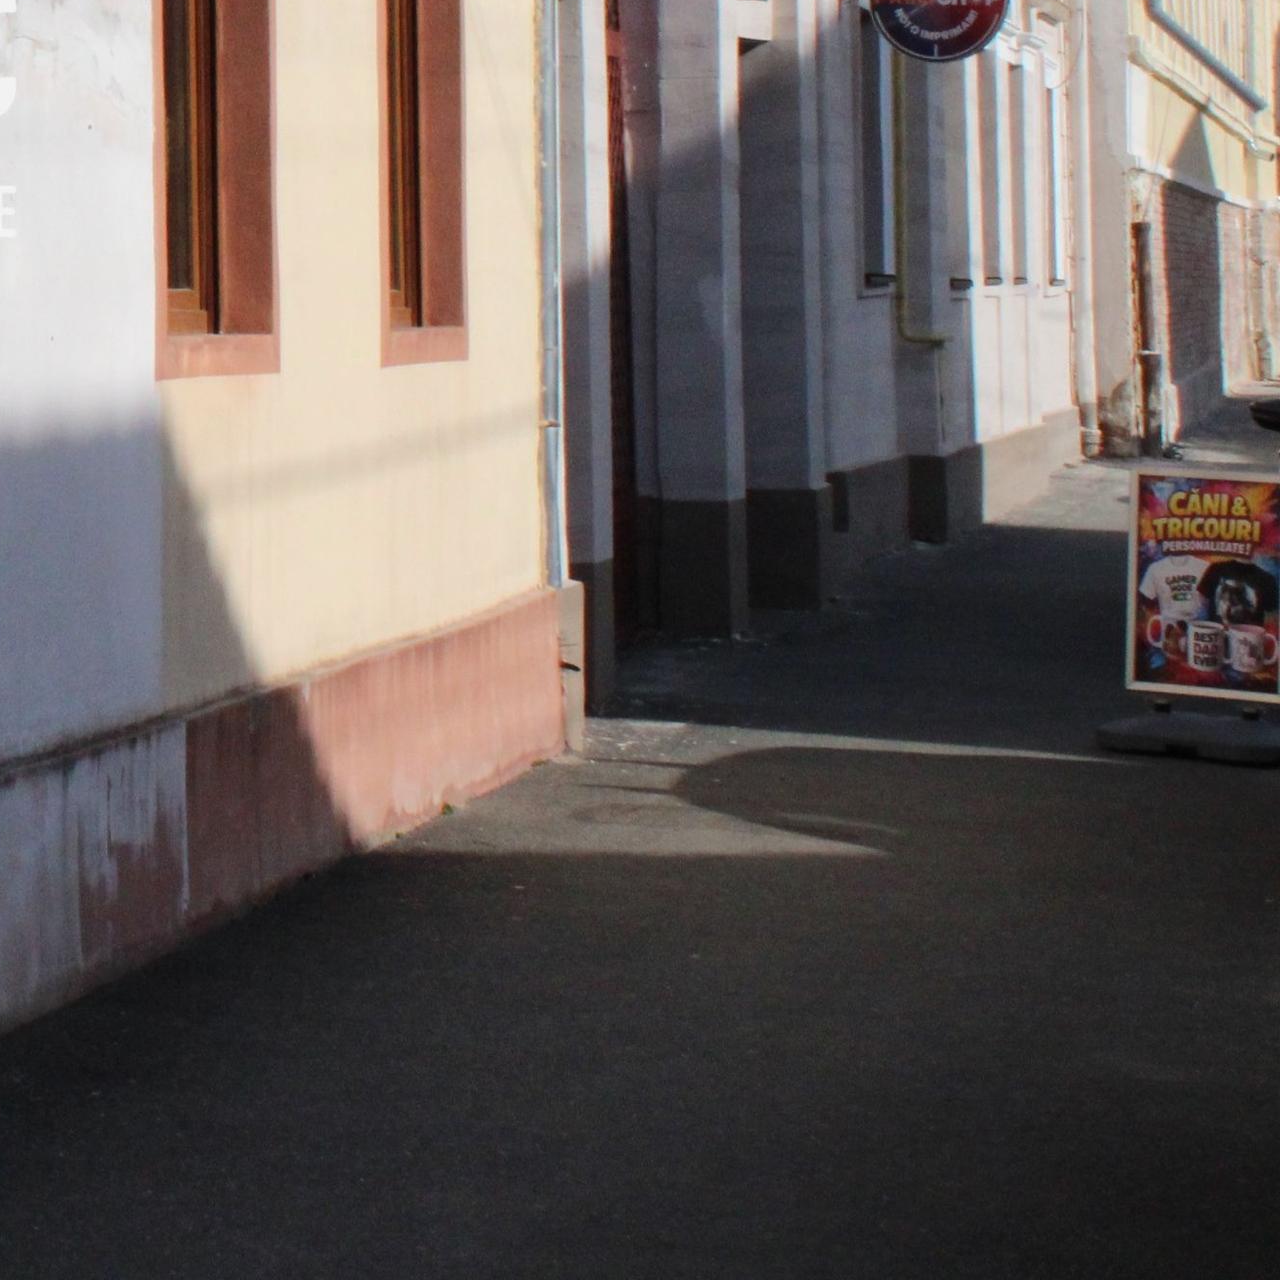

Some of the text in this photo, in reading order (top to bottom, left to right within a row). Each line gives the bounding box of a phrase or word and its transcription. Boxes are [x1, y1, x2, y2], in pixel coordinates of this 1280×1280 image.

[1168, 487, 1250, 517] CĂNI &
[1151, 516, 1261, 543] TRICOURI
